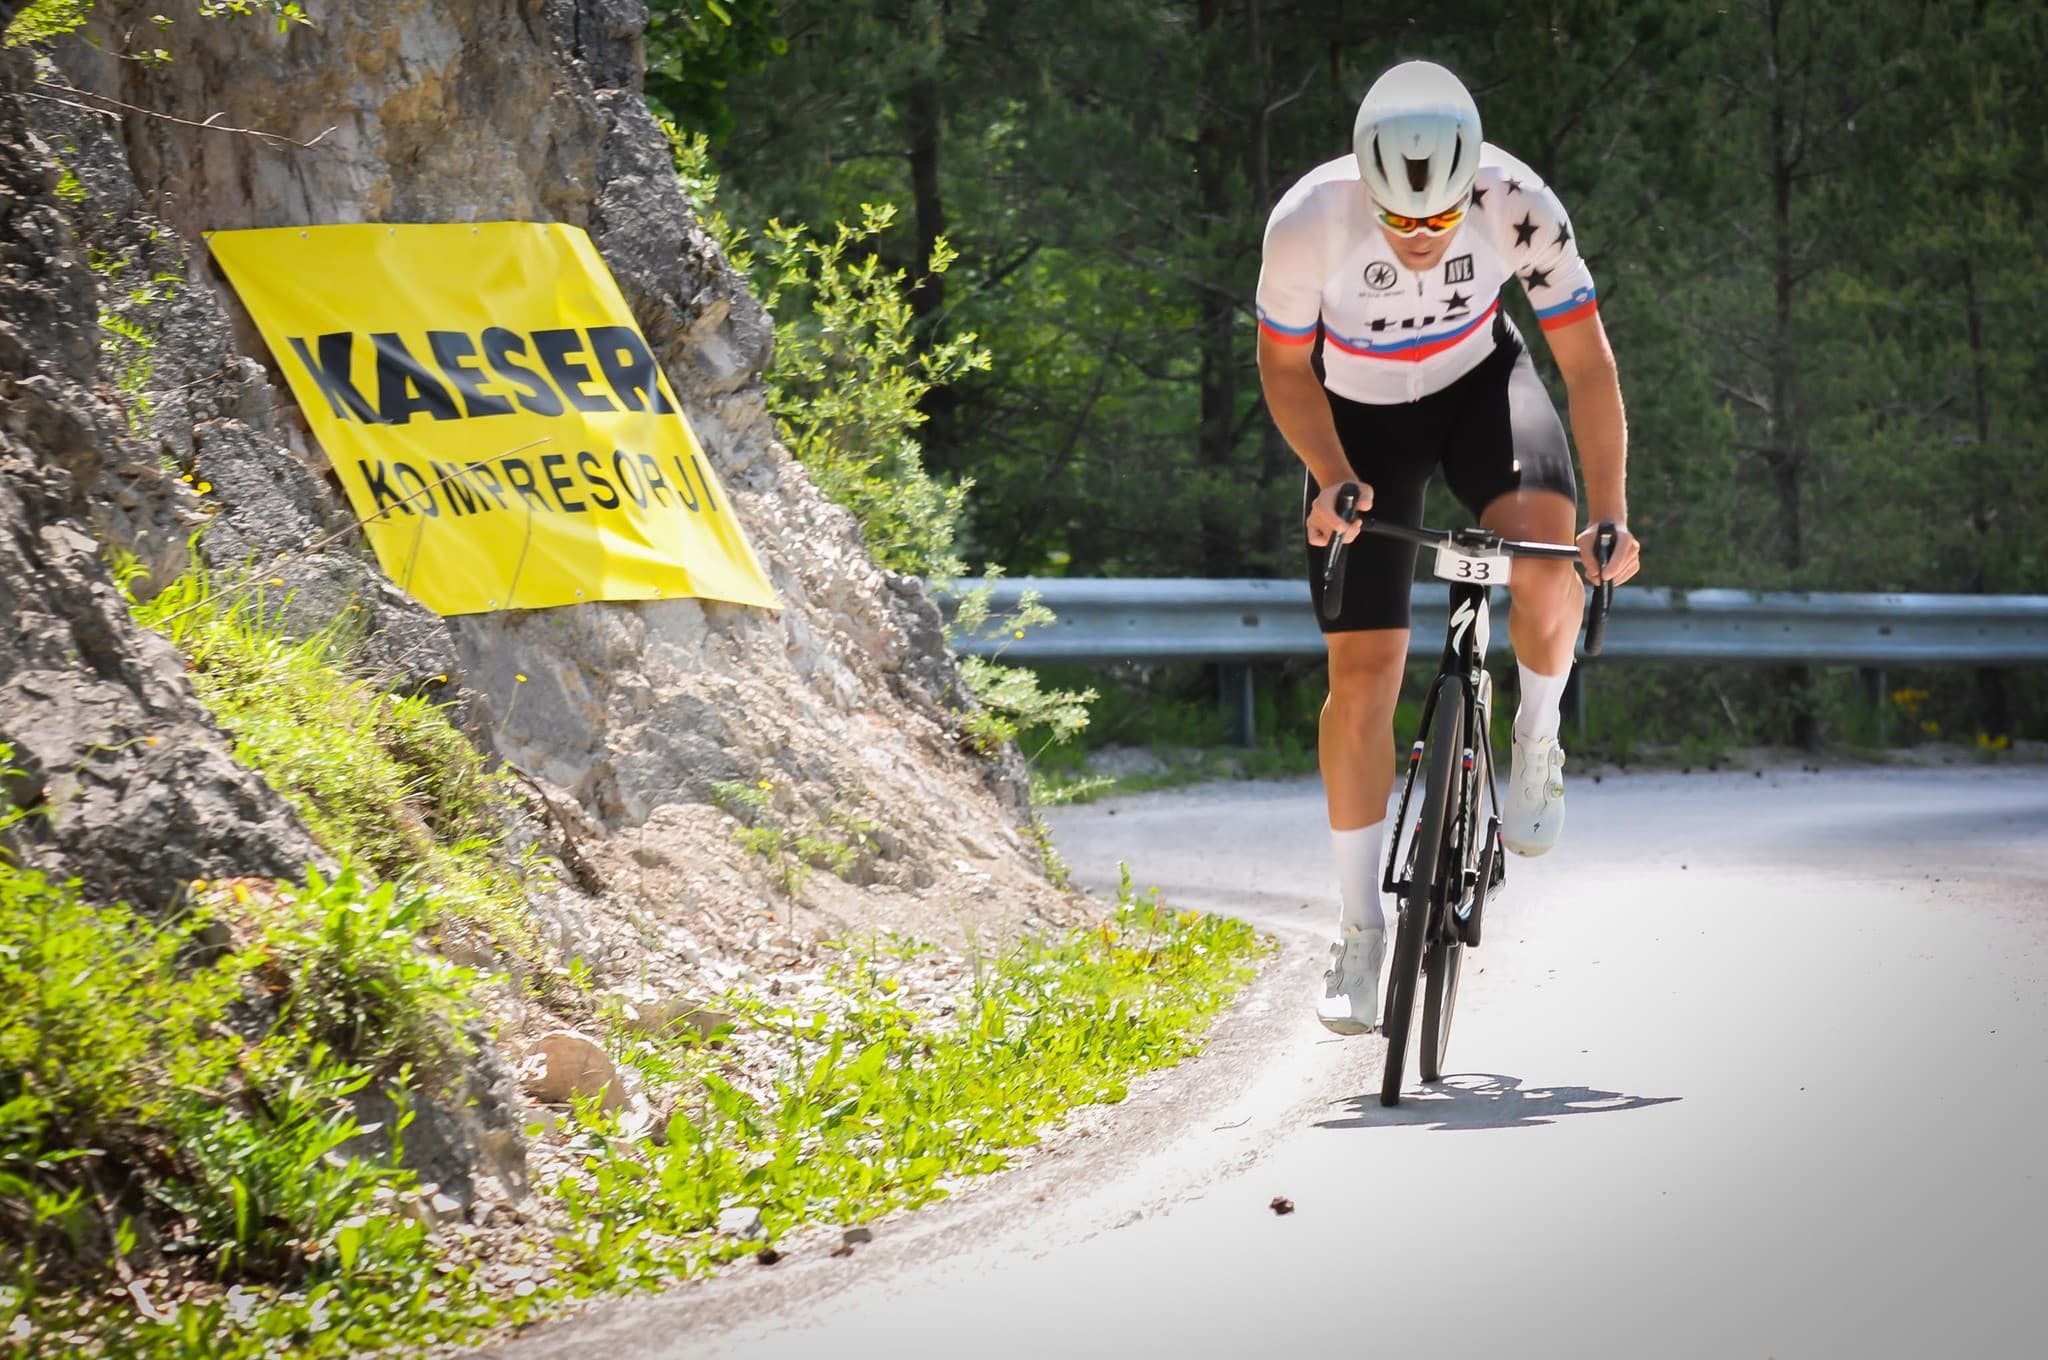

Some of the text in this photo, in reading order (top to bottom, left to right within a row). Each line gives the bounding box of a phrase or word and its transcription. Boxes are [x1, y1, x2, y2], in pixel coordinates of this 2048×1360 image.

[287, 326, 676, 425] KAESER
[358, 448, 717, 518] KOMPRESORJI
[1456, 559, 1490, 580] 33
